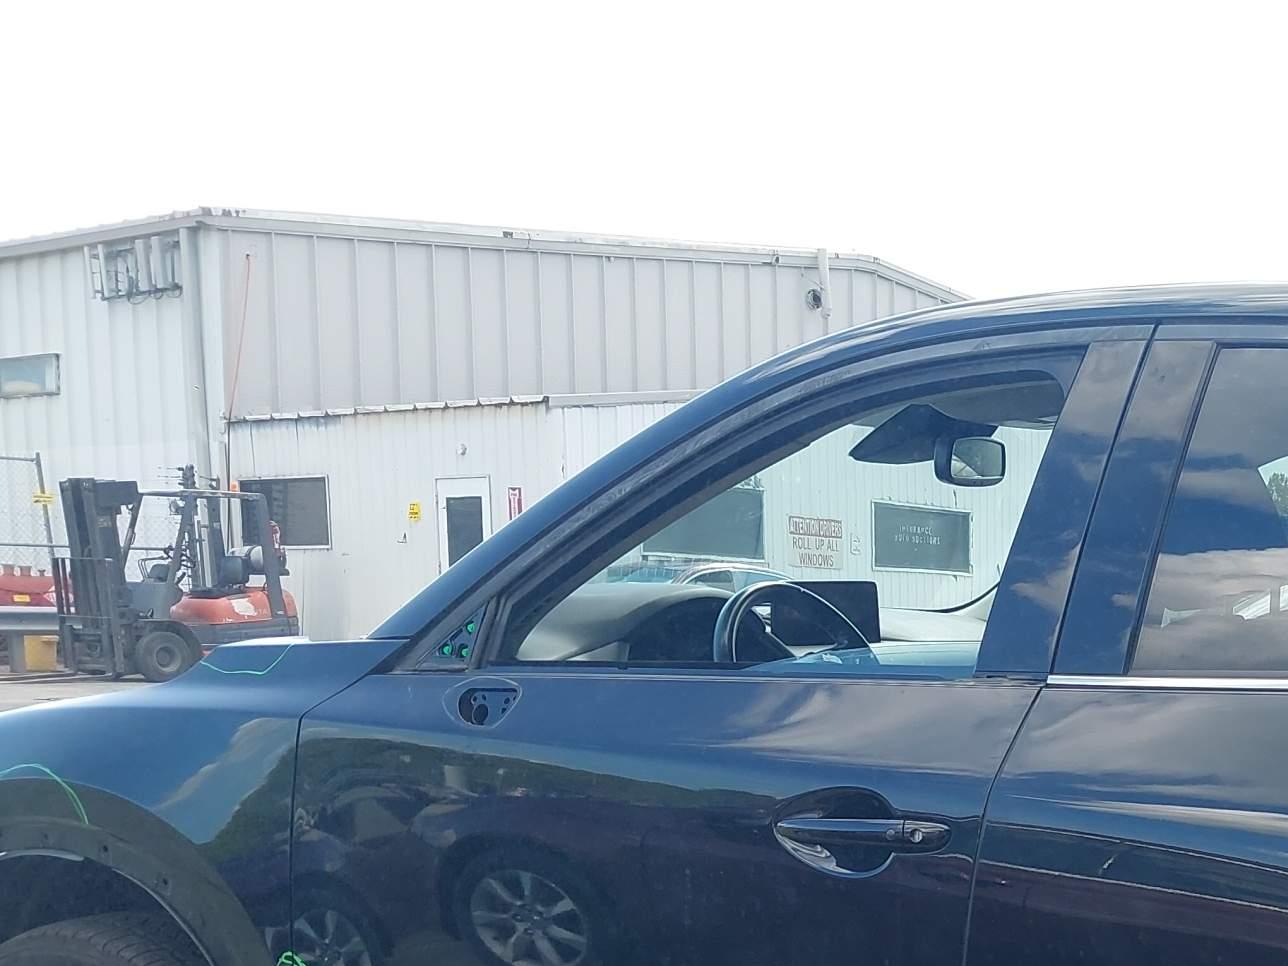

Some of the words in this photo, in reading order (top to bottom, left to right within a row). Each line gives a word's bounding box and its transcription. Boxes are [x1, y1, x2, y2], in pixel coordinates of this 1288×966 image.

[818, 519, 842, 536] DRIVERS
[792, 536, 812, 550] ROLL
[815, 538, 825, 550] UP
[827, 539, 840, 552] ALL
[798, 551, 834, 567] WINDOWS
